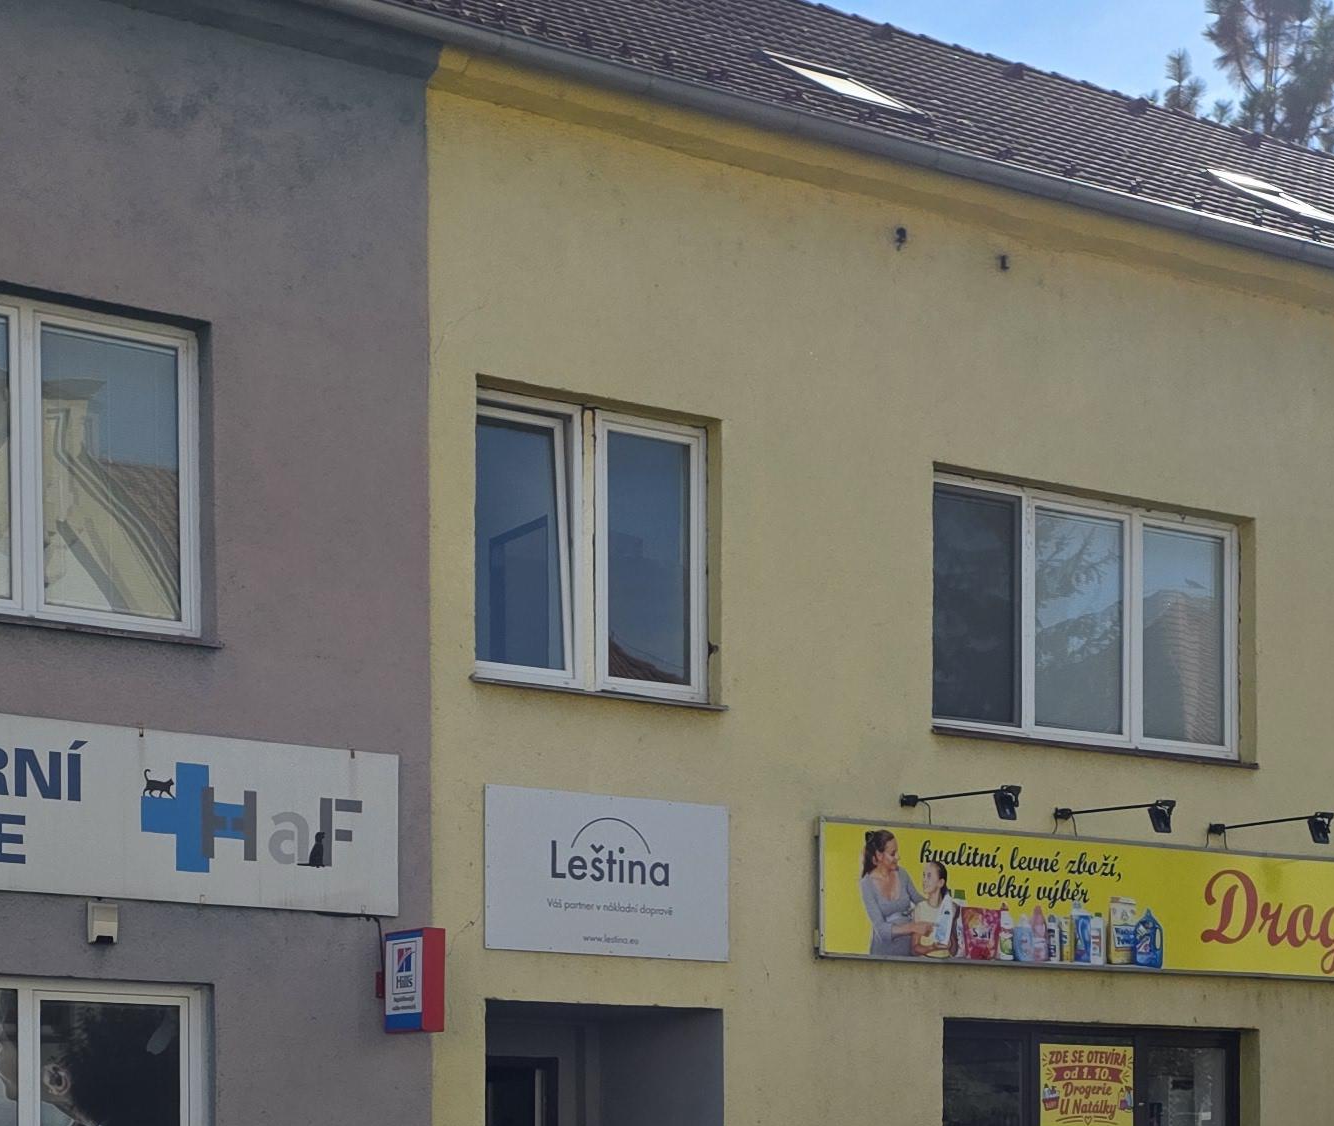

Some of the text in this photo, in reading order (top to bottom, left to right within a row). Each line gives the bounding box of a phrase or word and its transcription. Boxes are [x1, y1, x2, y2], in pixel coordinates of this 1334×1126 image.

[201, 786, 363, 869] HaF
[550, 839, 670, 887] Leština
[919, 839, 1123, 884] kvalitní, levné zboží,
[976, 874, 1091, 909] velký výběr
[546, 897, 563, 909] Váš
[564, 901, 595, 912] partner
[602, 900, 638, 913] nákladní
[639, 905, 674, 917] dopravě
[1048, 1048, 1127, 1066] ZDE SE OTEVÍRÁ
[1063, 1068, 1112, 1081] od 1. 10.
[1062, 1082, 1113, 1098] Drogerie
[1060, 1099, 1117, 1119] U Natálky
